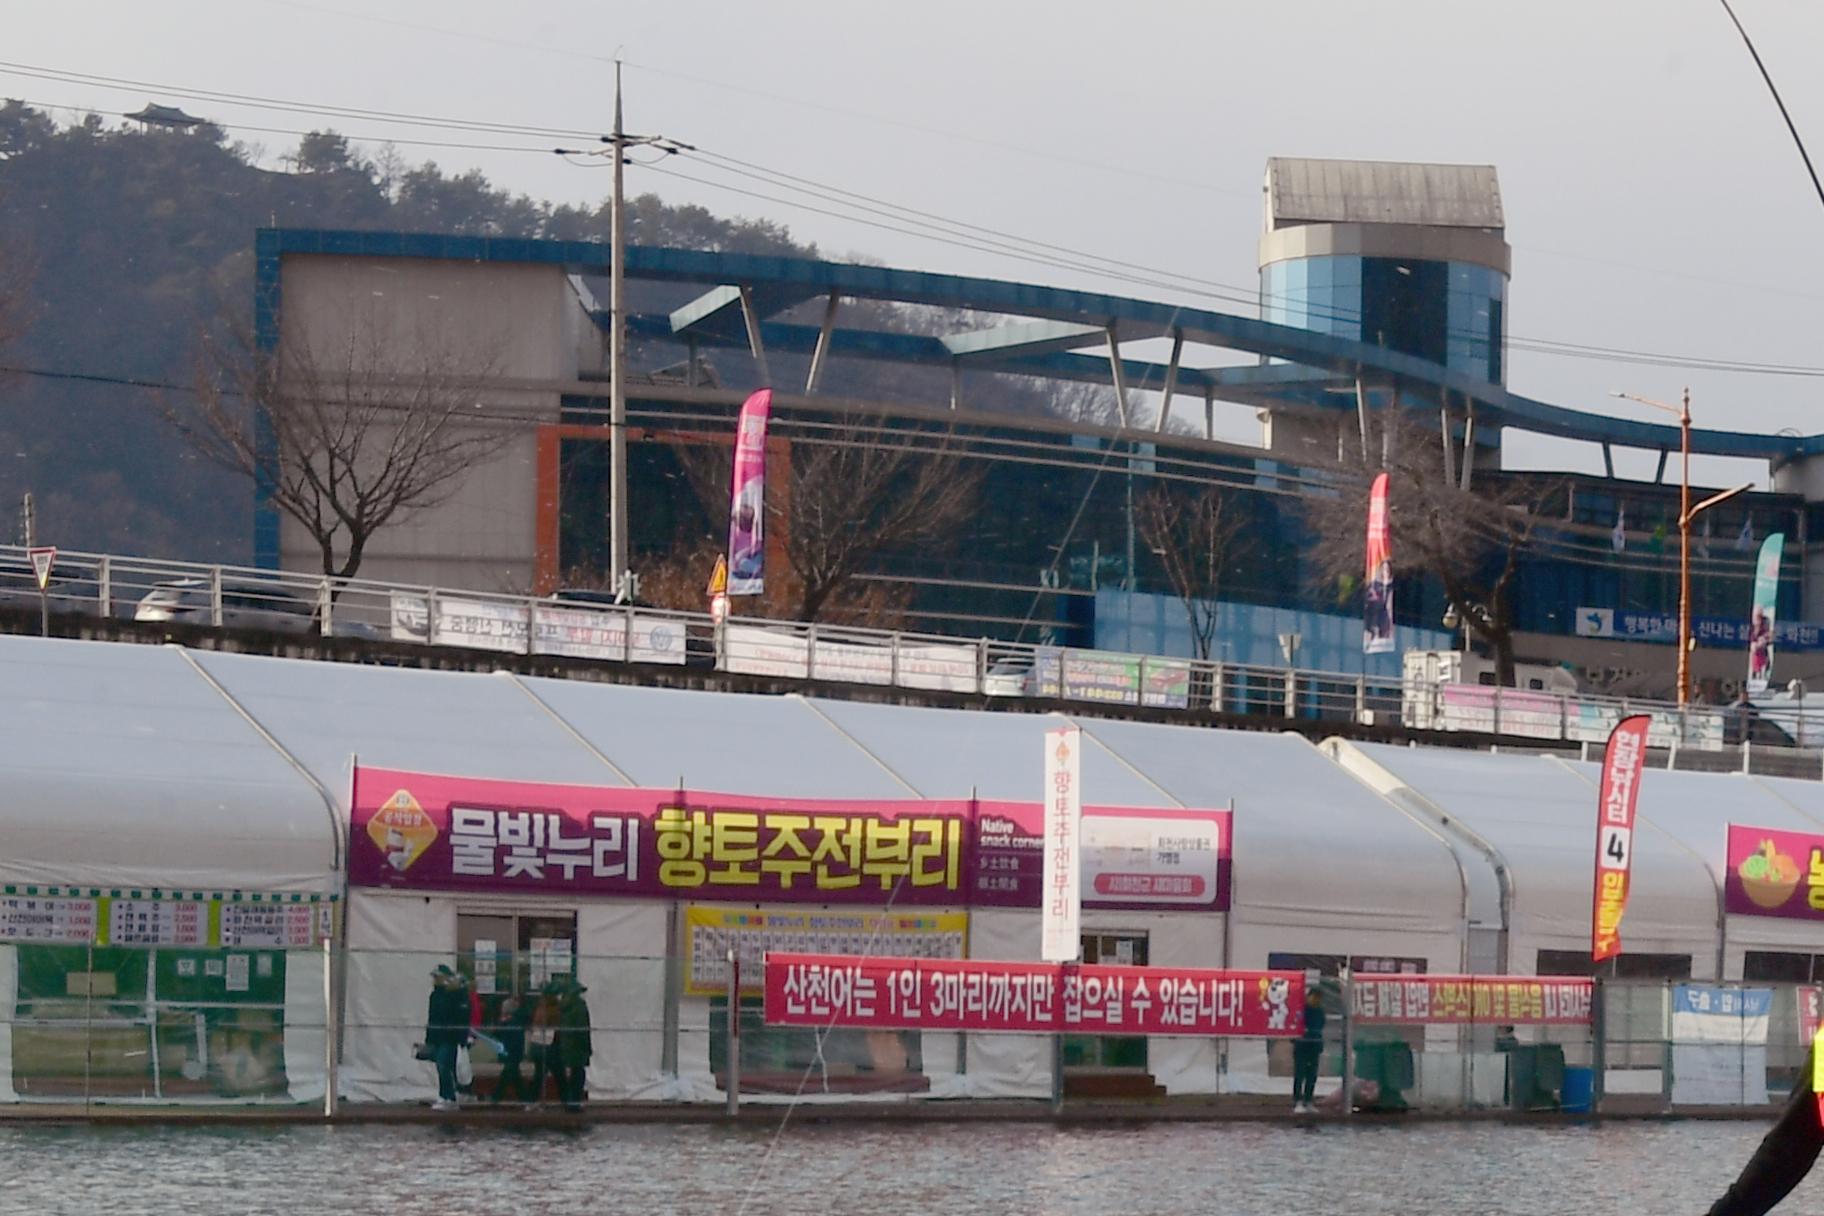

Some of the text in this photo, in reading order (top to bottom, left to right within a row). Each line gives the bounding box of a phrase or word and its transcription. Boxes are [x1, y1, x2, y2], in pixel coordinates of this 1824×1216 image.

[450, 807, 962, 891] 물빛누리 향토주전부리
[980, 834, 1009, 848] snack
[981, 818, 1014, 834] Native
[1053, 771, 1073, 920] 향토주전부리
[1606, 833, 1624, 863] 4
[783, 964, 1245, 1027] 산천어는 1인 3마리까지만 잡으실 수 있습니다!
